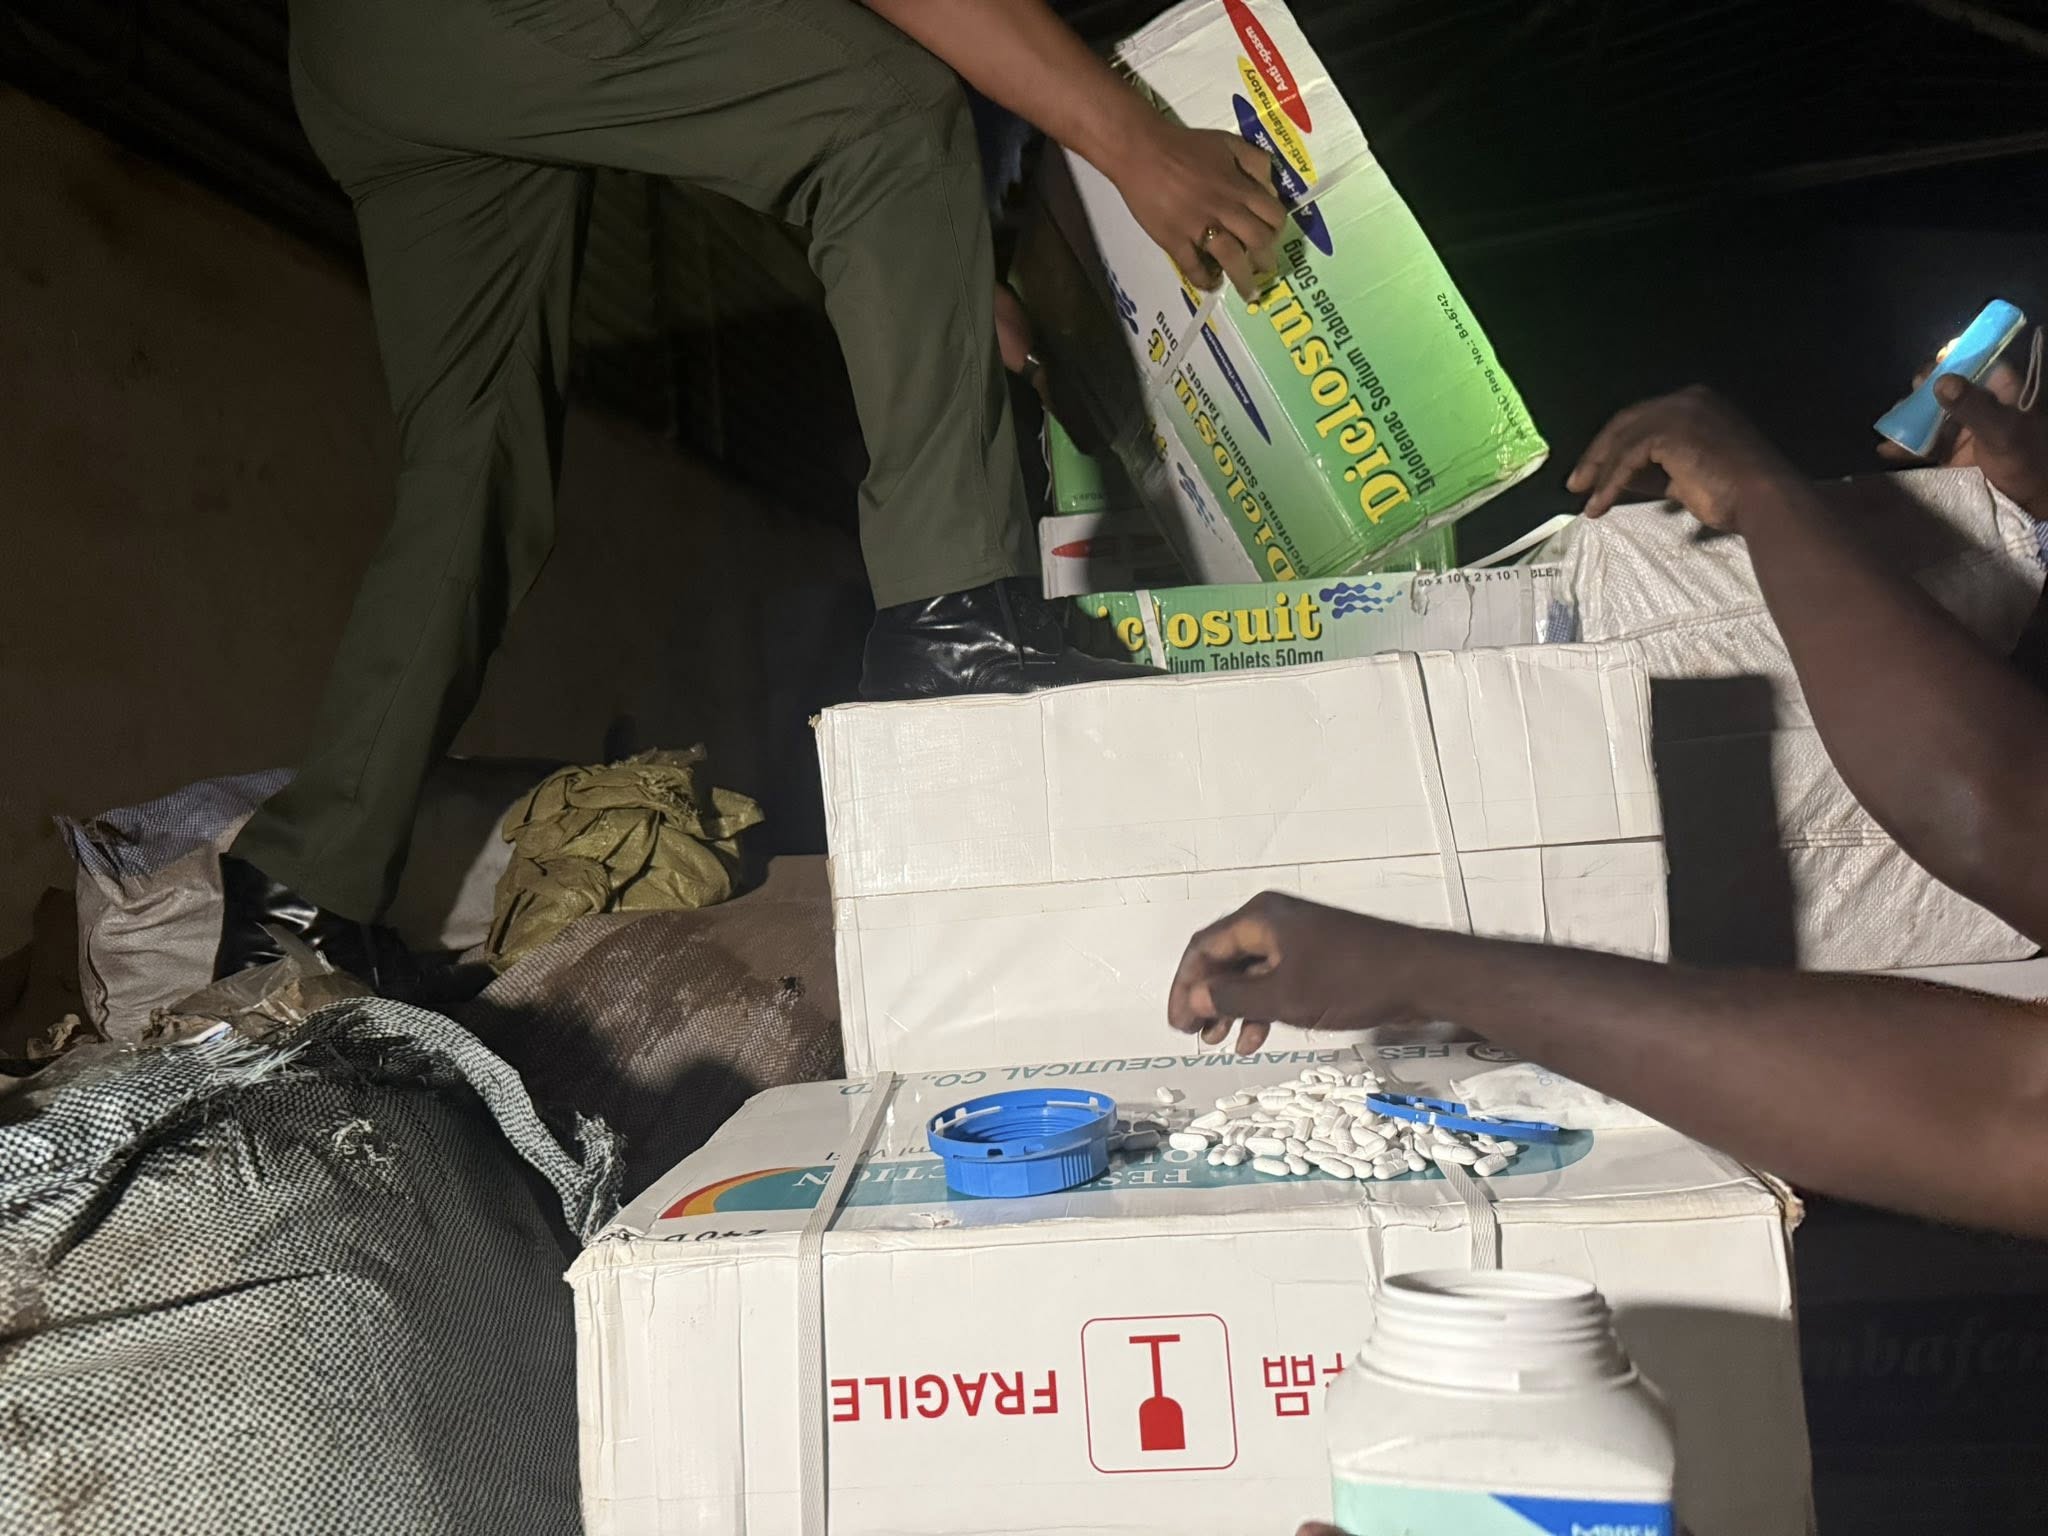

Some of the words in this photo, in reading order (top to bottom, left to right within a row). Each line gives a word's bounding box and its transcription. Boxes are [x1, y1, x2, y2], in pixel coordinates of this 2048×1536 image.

[1242, 23, 1289, 93] Anti-spasm
[1242, 65, 1311, 175] Anti-inflammatory
[1278, 236, 1322, 291] 50mg
[1306, 286, 1355, 351] Tablets
[1181, 361, 1222, 422] Tablets
[1241, 273, 1416, 526] Diclosui
[1340, 345, 1392, 414] Sodium
[1480, 364, 1504, 394] Reg.
[1217, 424, 1259, 488] Sodium
[1448, 574, 1461, 583] 10
[1473, 572, 1482, 582] 2
[1496, 571, 1510, 580] 10
[1002, 1050, 1340, 1081] PHARMACEUTICAL
[831, 1370, 1059, 1422] FRAGILE
